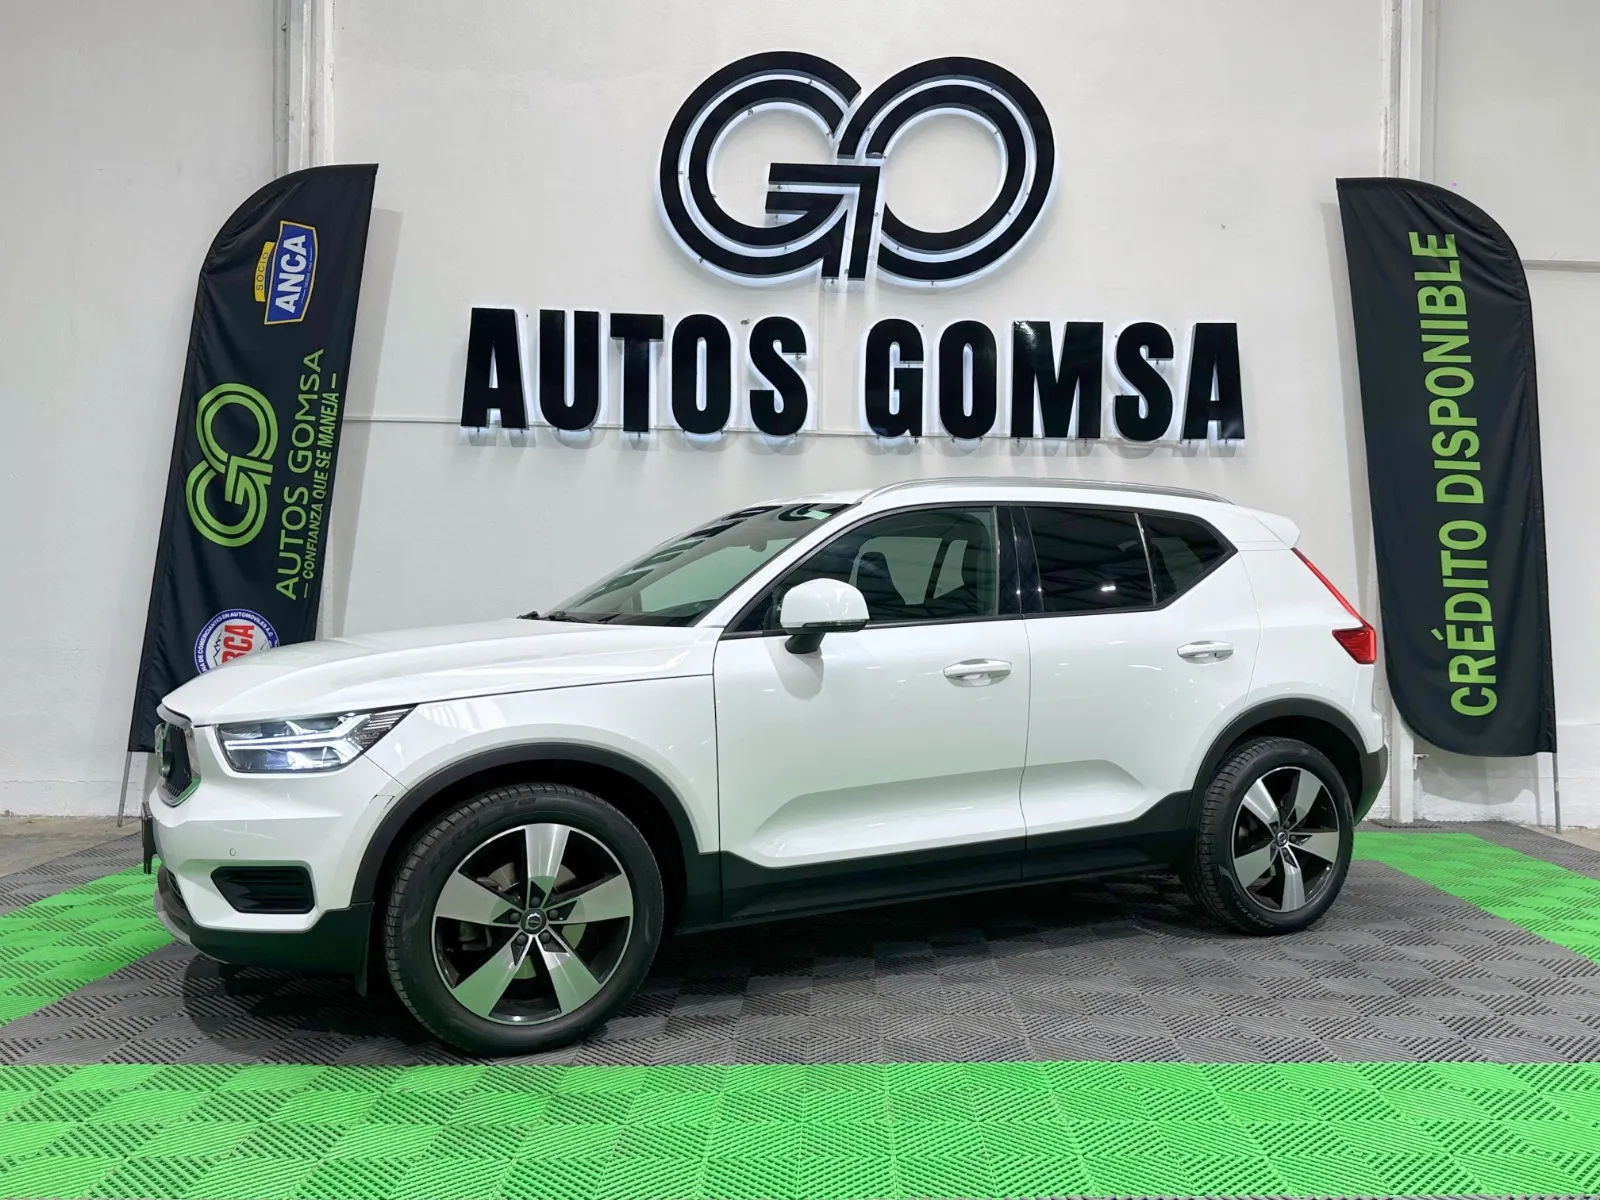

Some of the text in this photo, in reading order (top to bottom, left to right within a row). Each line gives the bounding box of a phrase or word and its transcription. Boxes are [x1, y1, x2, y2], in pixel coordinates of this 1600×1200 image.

[256, 252, 269, 291] SOCIO
[275, 235, 307, 313] ANCA
[460, 307, 1245, 442] AUTOS GOMSA
[276, 349, 324, 600] AUTOS GOMSA
[302, 393, 340, 580] CONFIANZA QUE SE MANEJA
[1409, 231, 1498, 717] CRÉDITO DISPONIBLE
[197, 616, 223, 654] COMERCIANTES
